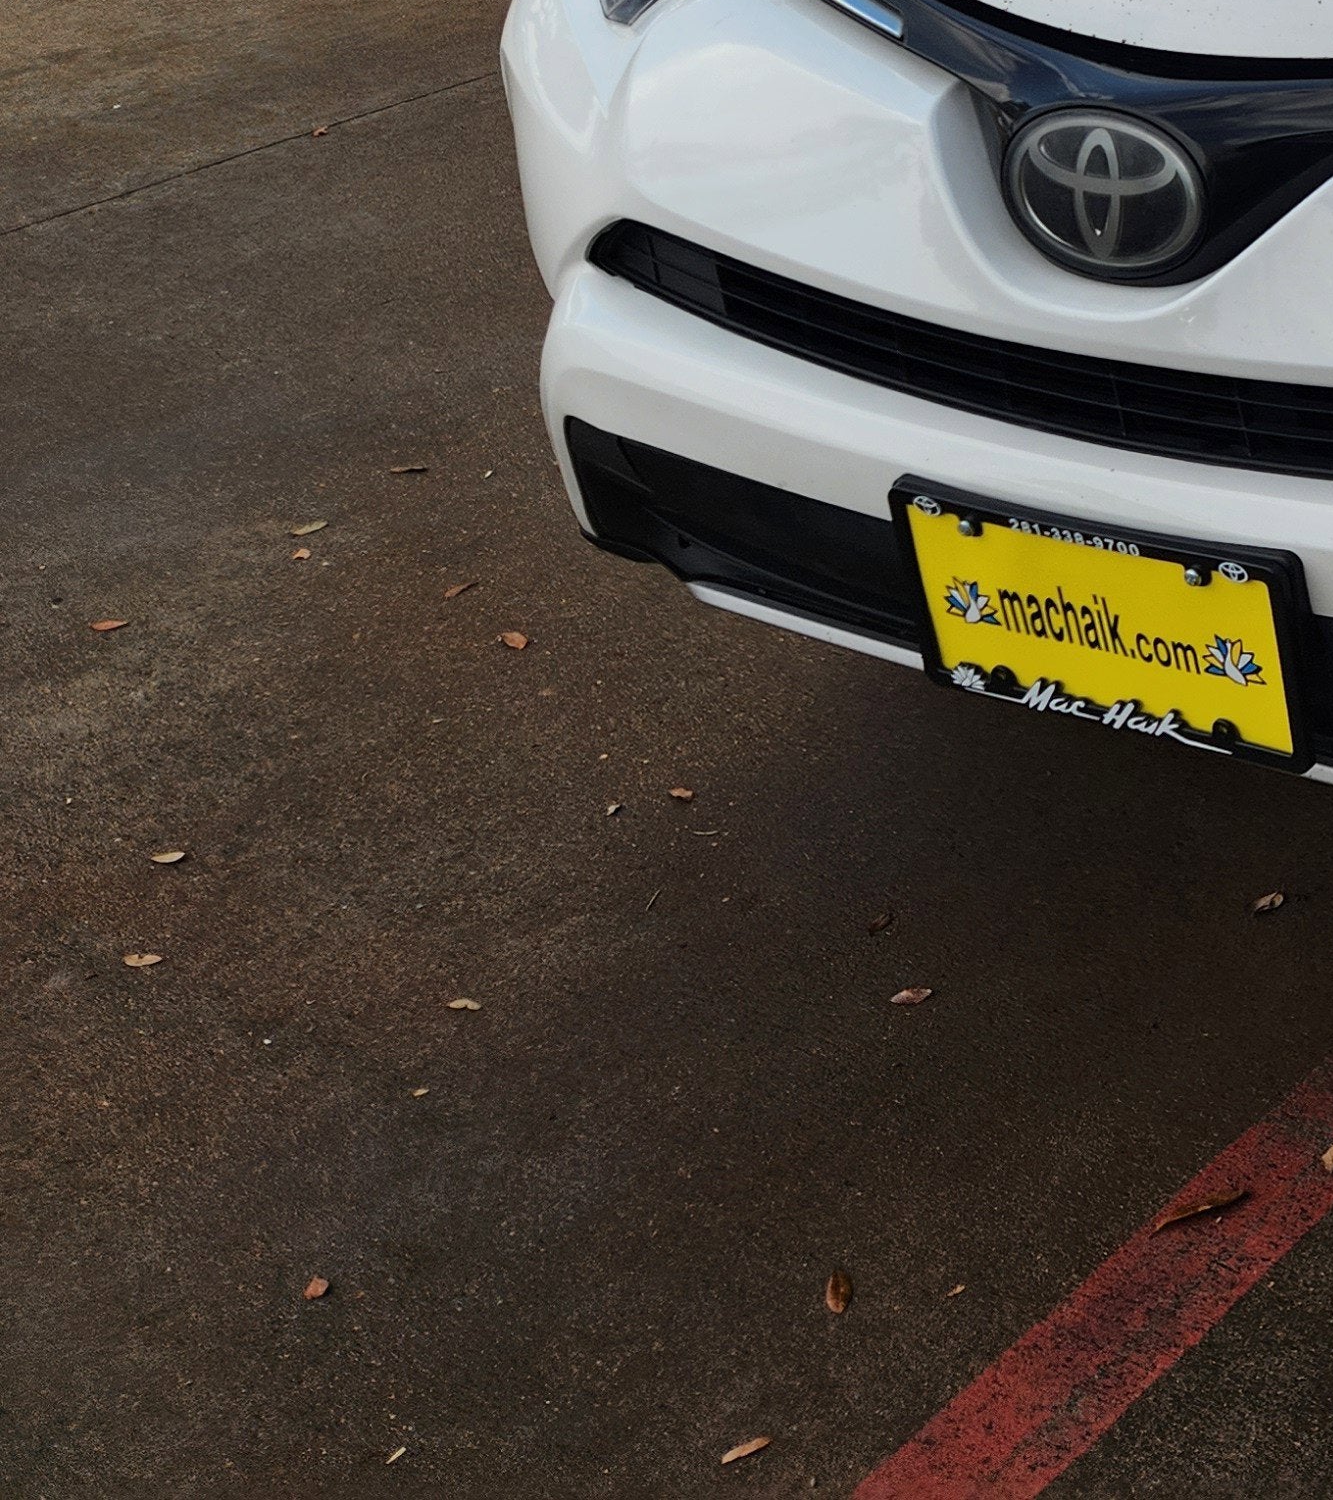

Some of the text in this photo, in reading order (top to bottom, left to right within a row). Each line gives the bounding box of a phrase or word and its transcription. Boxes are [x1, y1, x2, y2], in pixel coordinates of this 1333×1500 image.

[1008, 517, 1141, 557] 281-338-9700
[997, 586, 1202, 675] machaik.com
[1020, 680, 1100, 721] Mac
